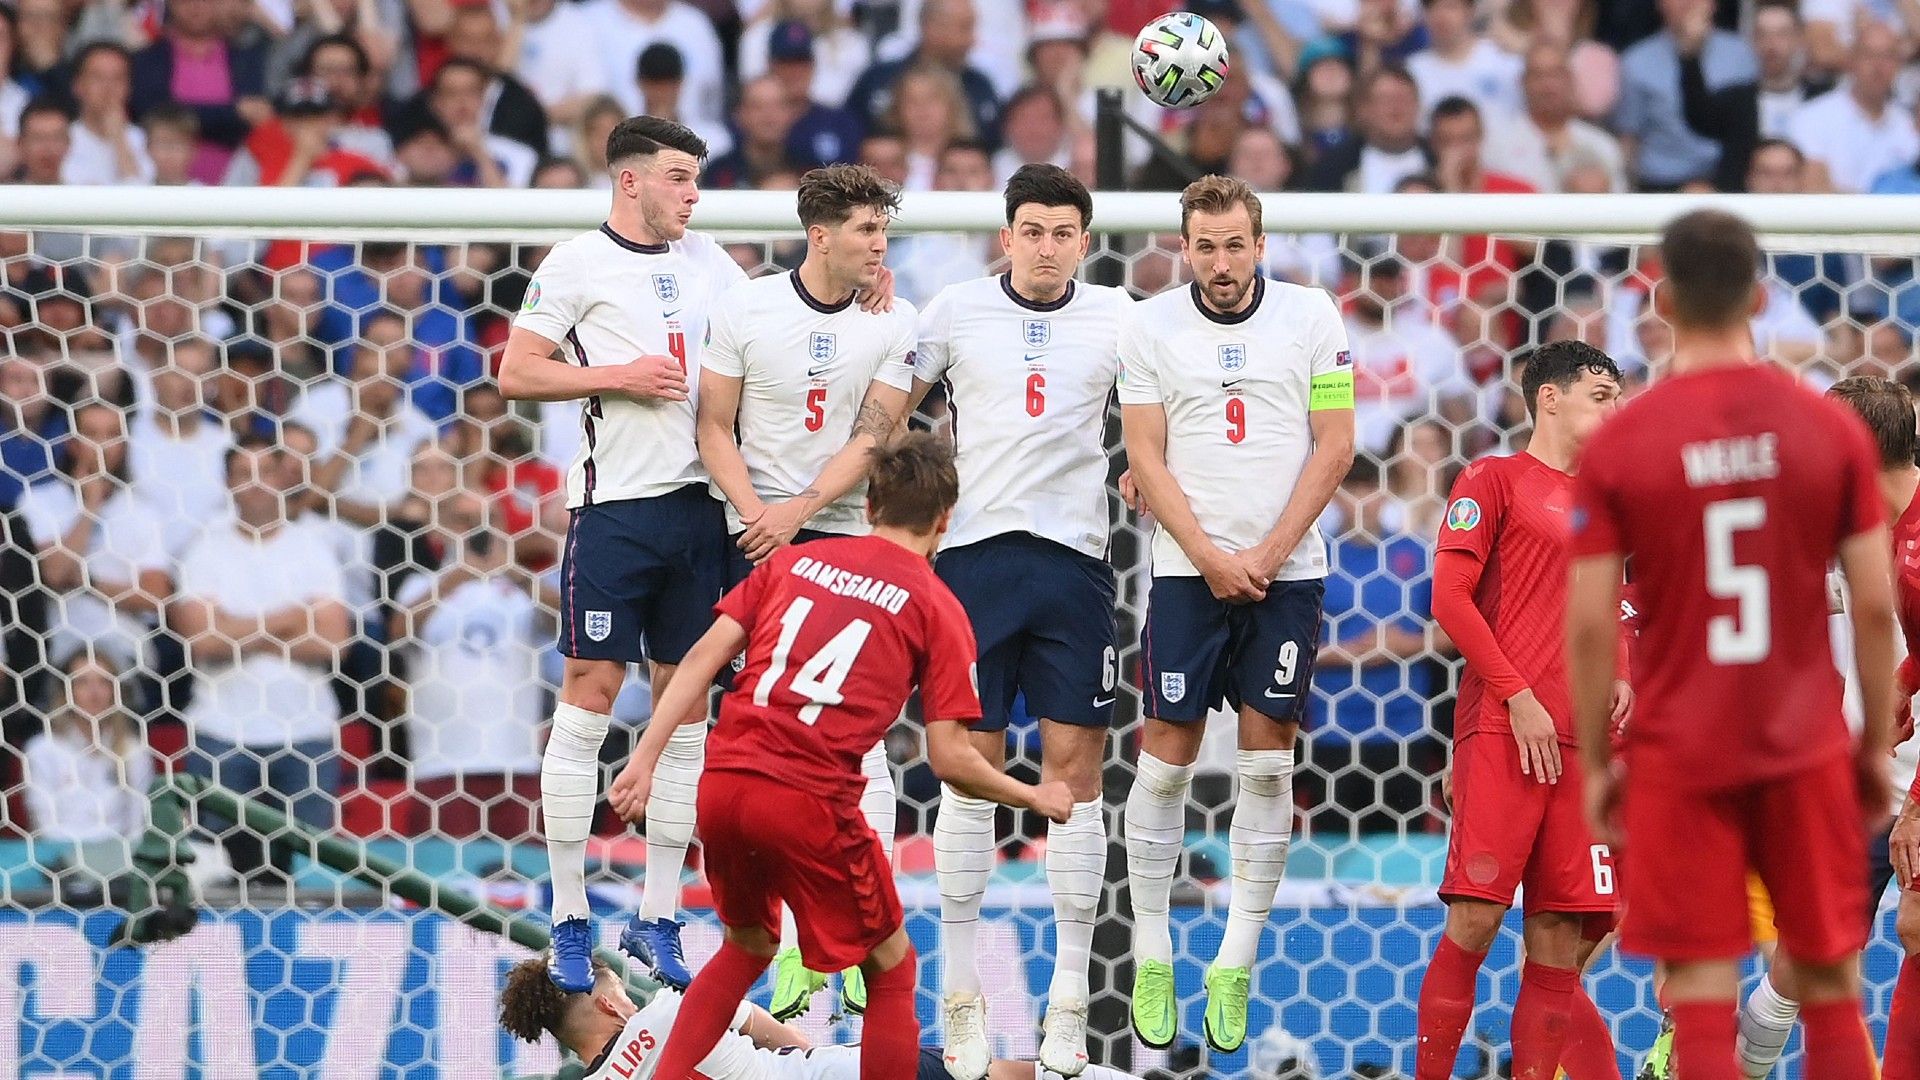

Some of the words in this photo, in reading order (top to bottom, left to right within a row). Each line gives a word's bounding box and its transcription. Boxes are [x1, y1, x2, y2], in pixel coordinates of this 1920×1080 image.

[667, 332, 688, 377] 4
[804, 388, 827, 432] 5
[1025, 373, 1046, 418] 6
[1225, 397, 1246, 444] 9
[790, 556, 911, 616] DAMSGAARD
[1704, 497, 1771, 664] 5
[752, 595, 873, 727] 14
[1101, 644, 1117, 692] 6
[1273, 640, 1300, 686] 9
[1589, 844, 1614, 895] 6
[605, 1028, 656, 1080] LIPS
